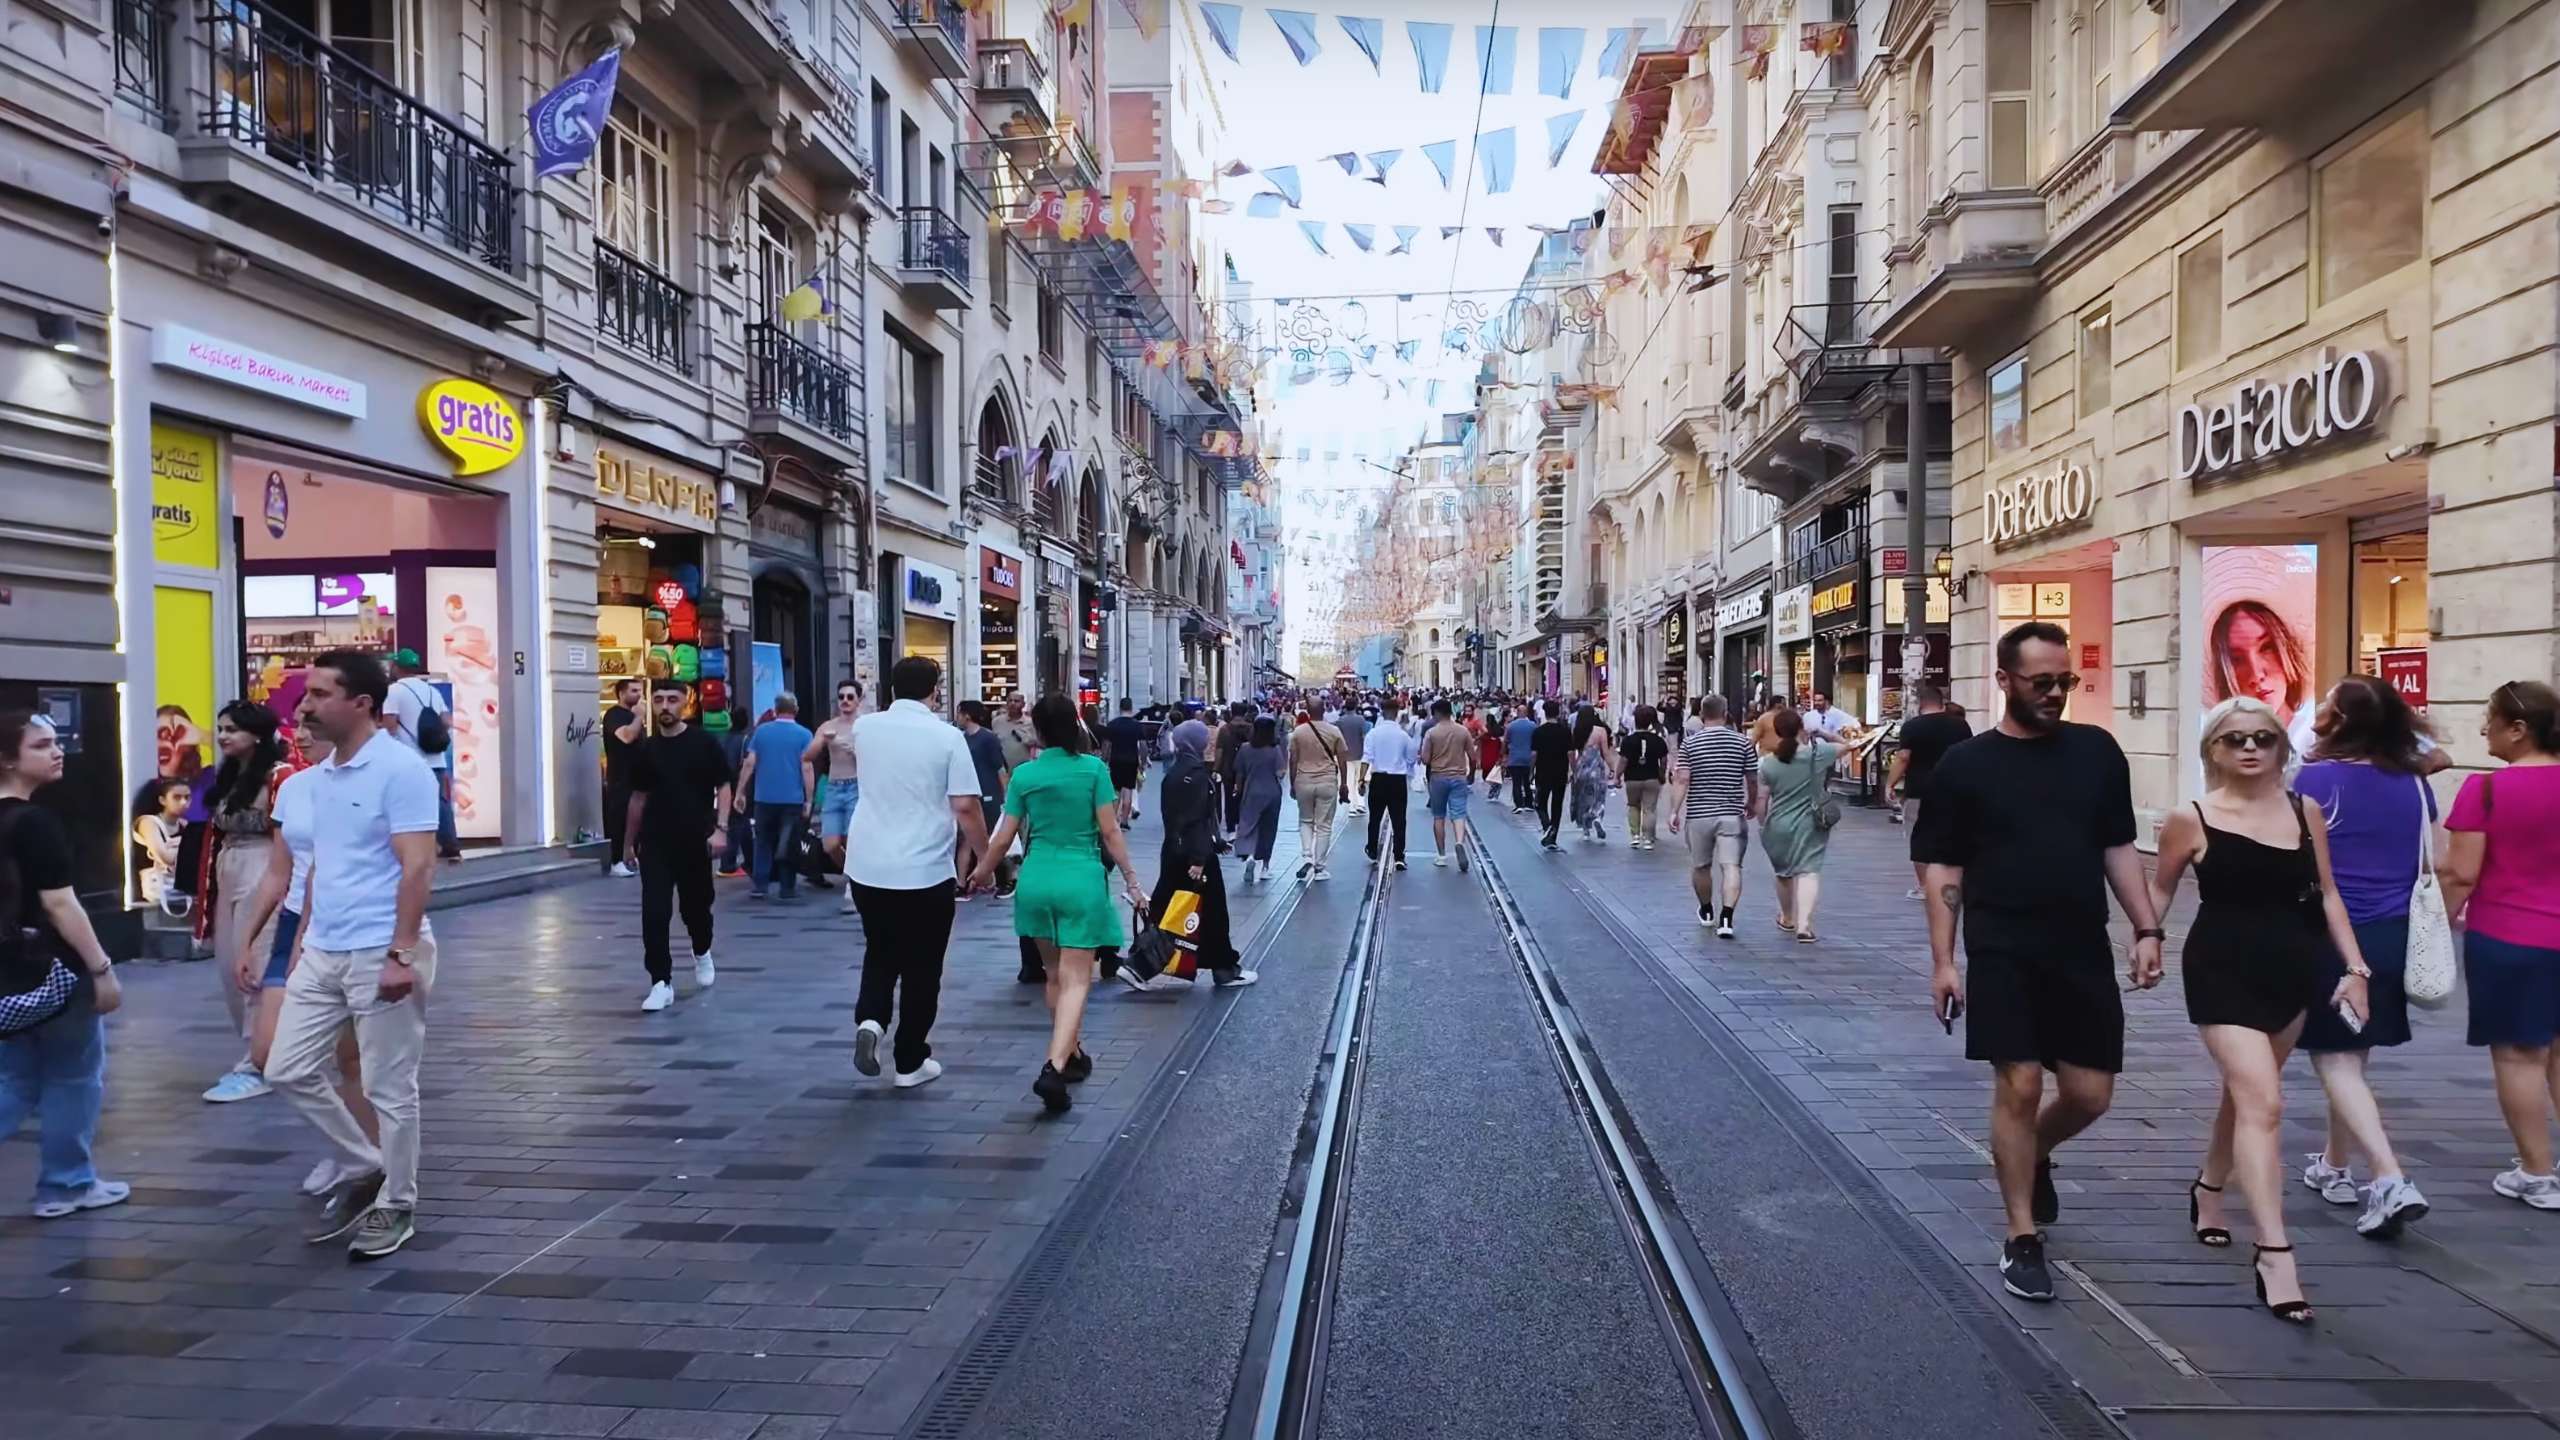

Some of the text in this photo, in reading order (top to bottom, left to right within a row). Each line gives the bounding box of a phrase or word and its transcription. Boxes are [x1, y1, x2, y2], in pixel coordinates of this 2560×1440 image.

[438, 394, 514, 443] gratis
[2175, 350, 2376, 481] DeFacto
[1983, 459, 2092, 545] DeFacto
[992, 566, 1015, 588] TUDORS
[2042, 591, 2064, 606] +3
[2402, 673, 2421, 693] AL
